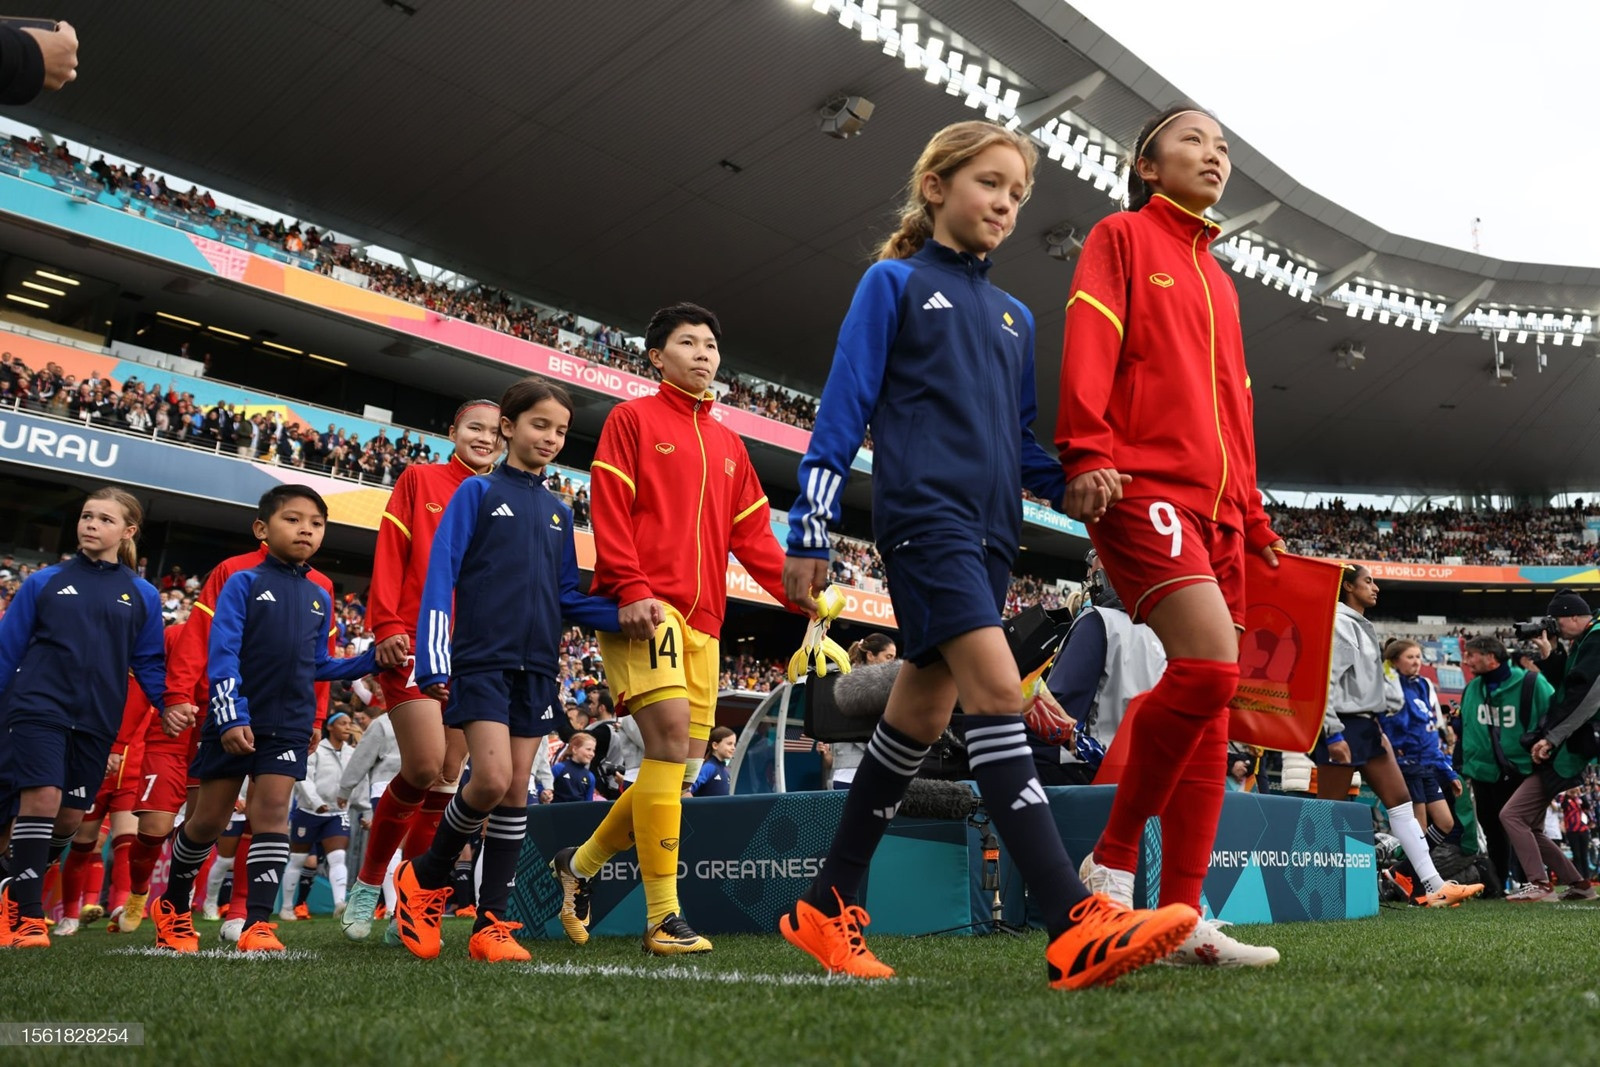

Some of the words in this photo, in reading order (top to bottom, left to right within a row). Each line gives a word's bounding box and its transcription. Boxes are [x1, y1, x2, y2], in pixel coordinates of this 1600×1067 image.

[548, 355, 623, 391] BEYOND
[1149, 501, 1182, 558] 9
[1385, 566, 1426, 578] WORLD
[649, 627, 678, 670] 14
[141, 774, 158, 802] 7
[1251, 850, 1289, 868] WORLD
[1291, 851, 1312, 868] CUP
